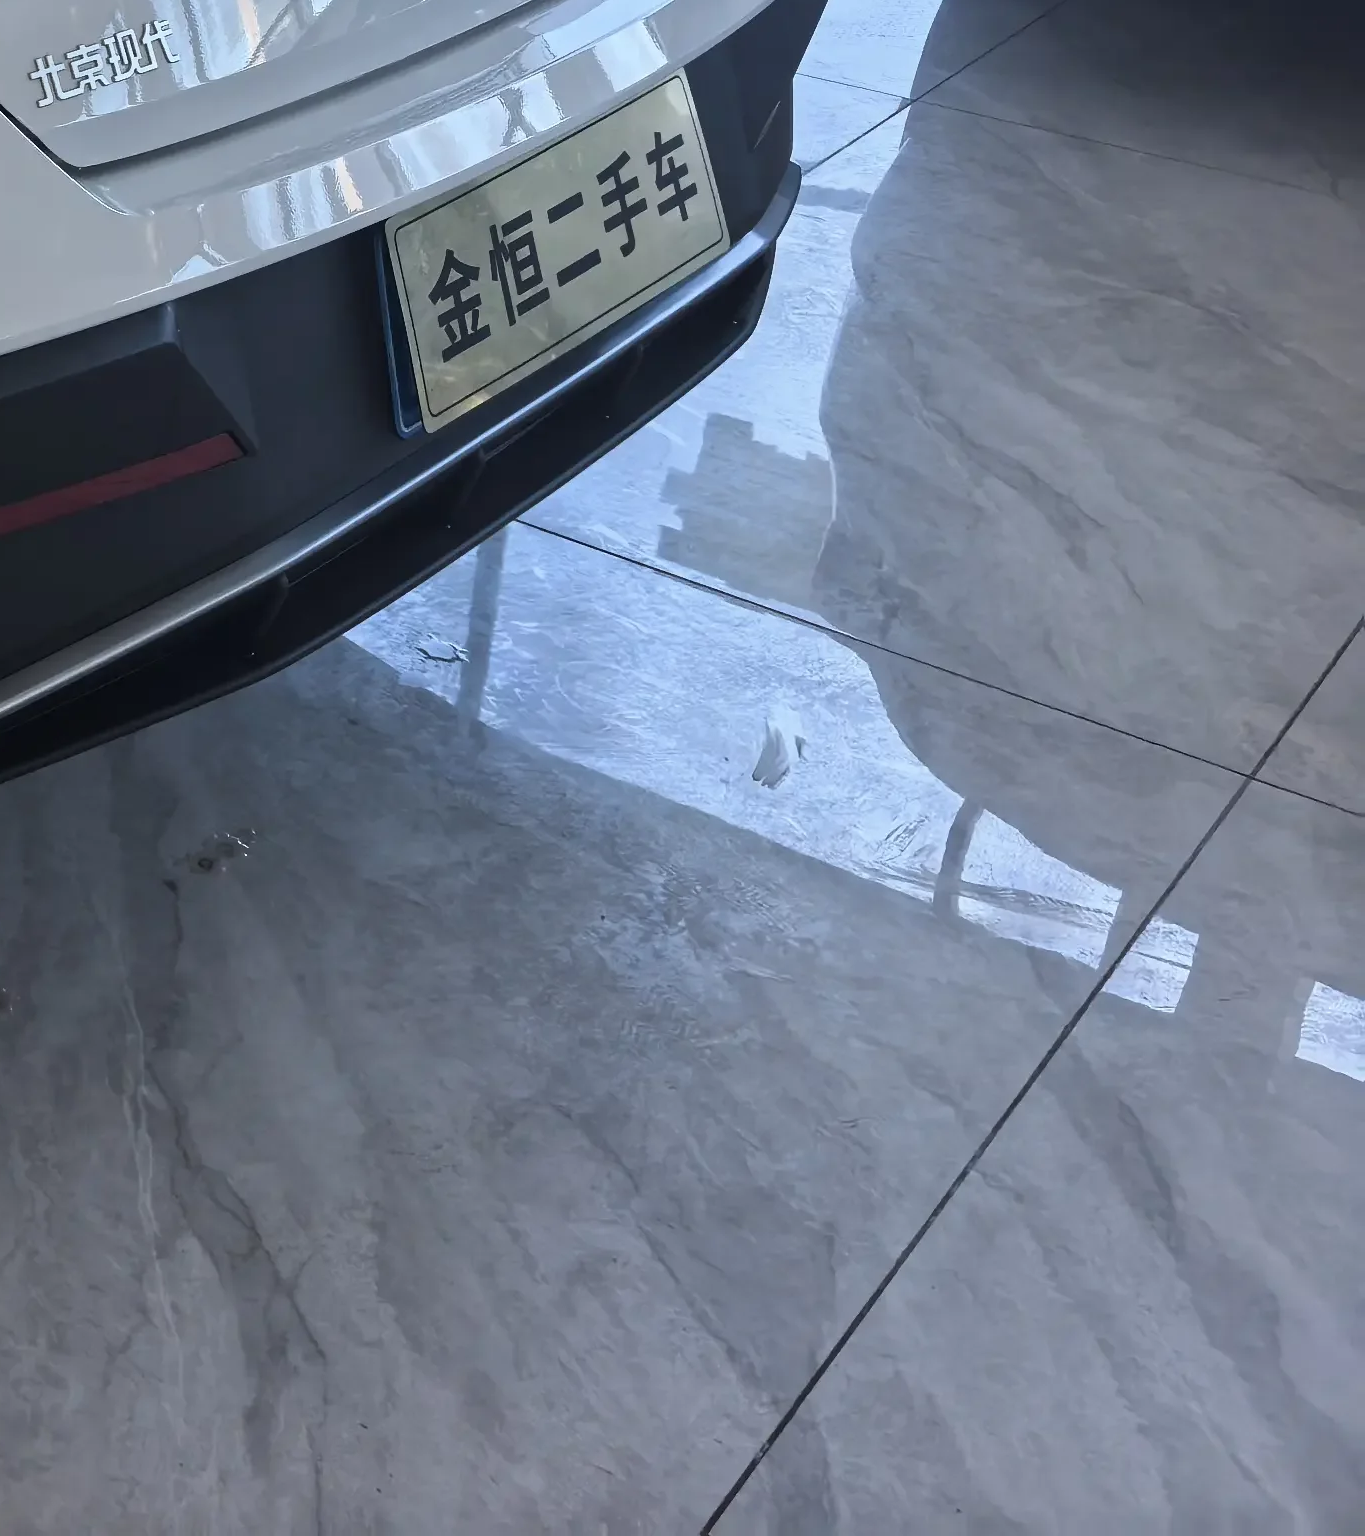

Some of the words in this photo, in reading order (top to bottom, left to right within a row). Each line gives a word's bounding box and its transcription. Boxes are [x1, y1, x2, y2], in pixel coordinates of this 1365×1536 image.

[28, 19, 182, 108] 北京现代
[428, 131, 698, 364] 金恒二手车
